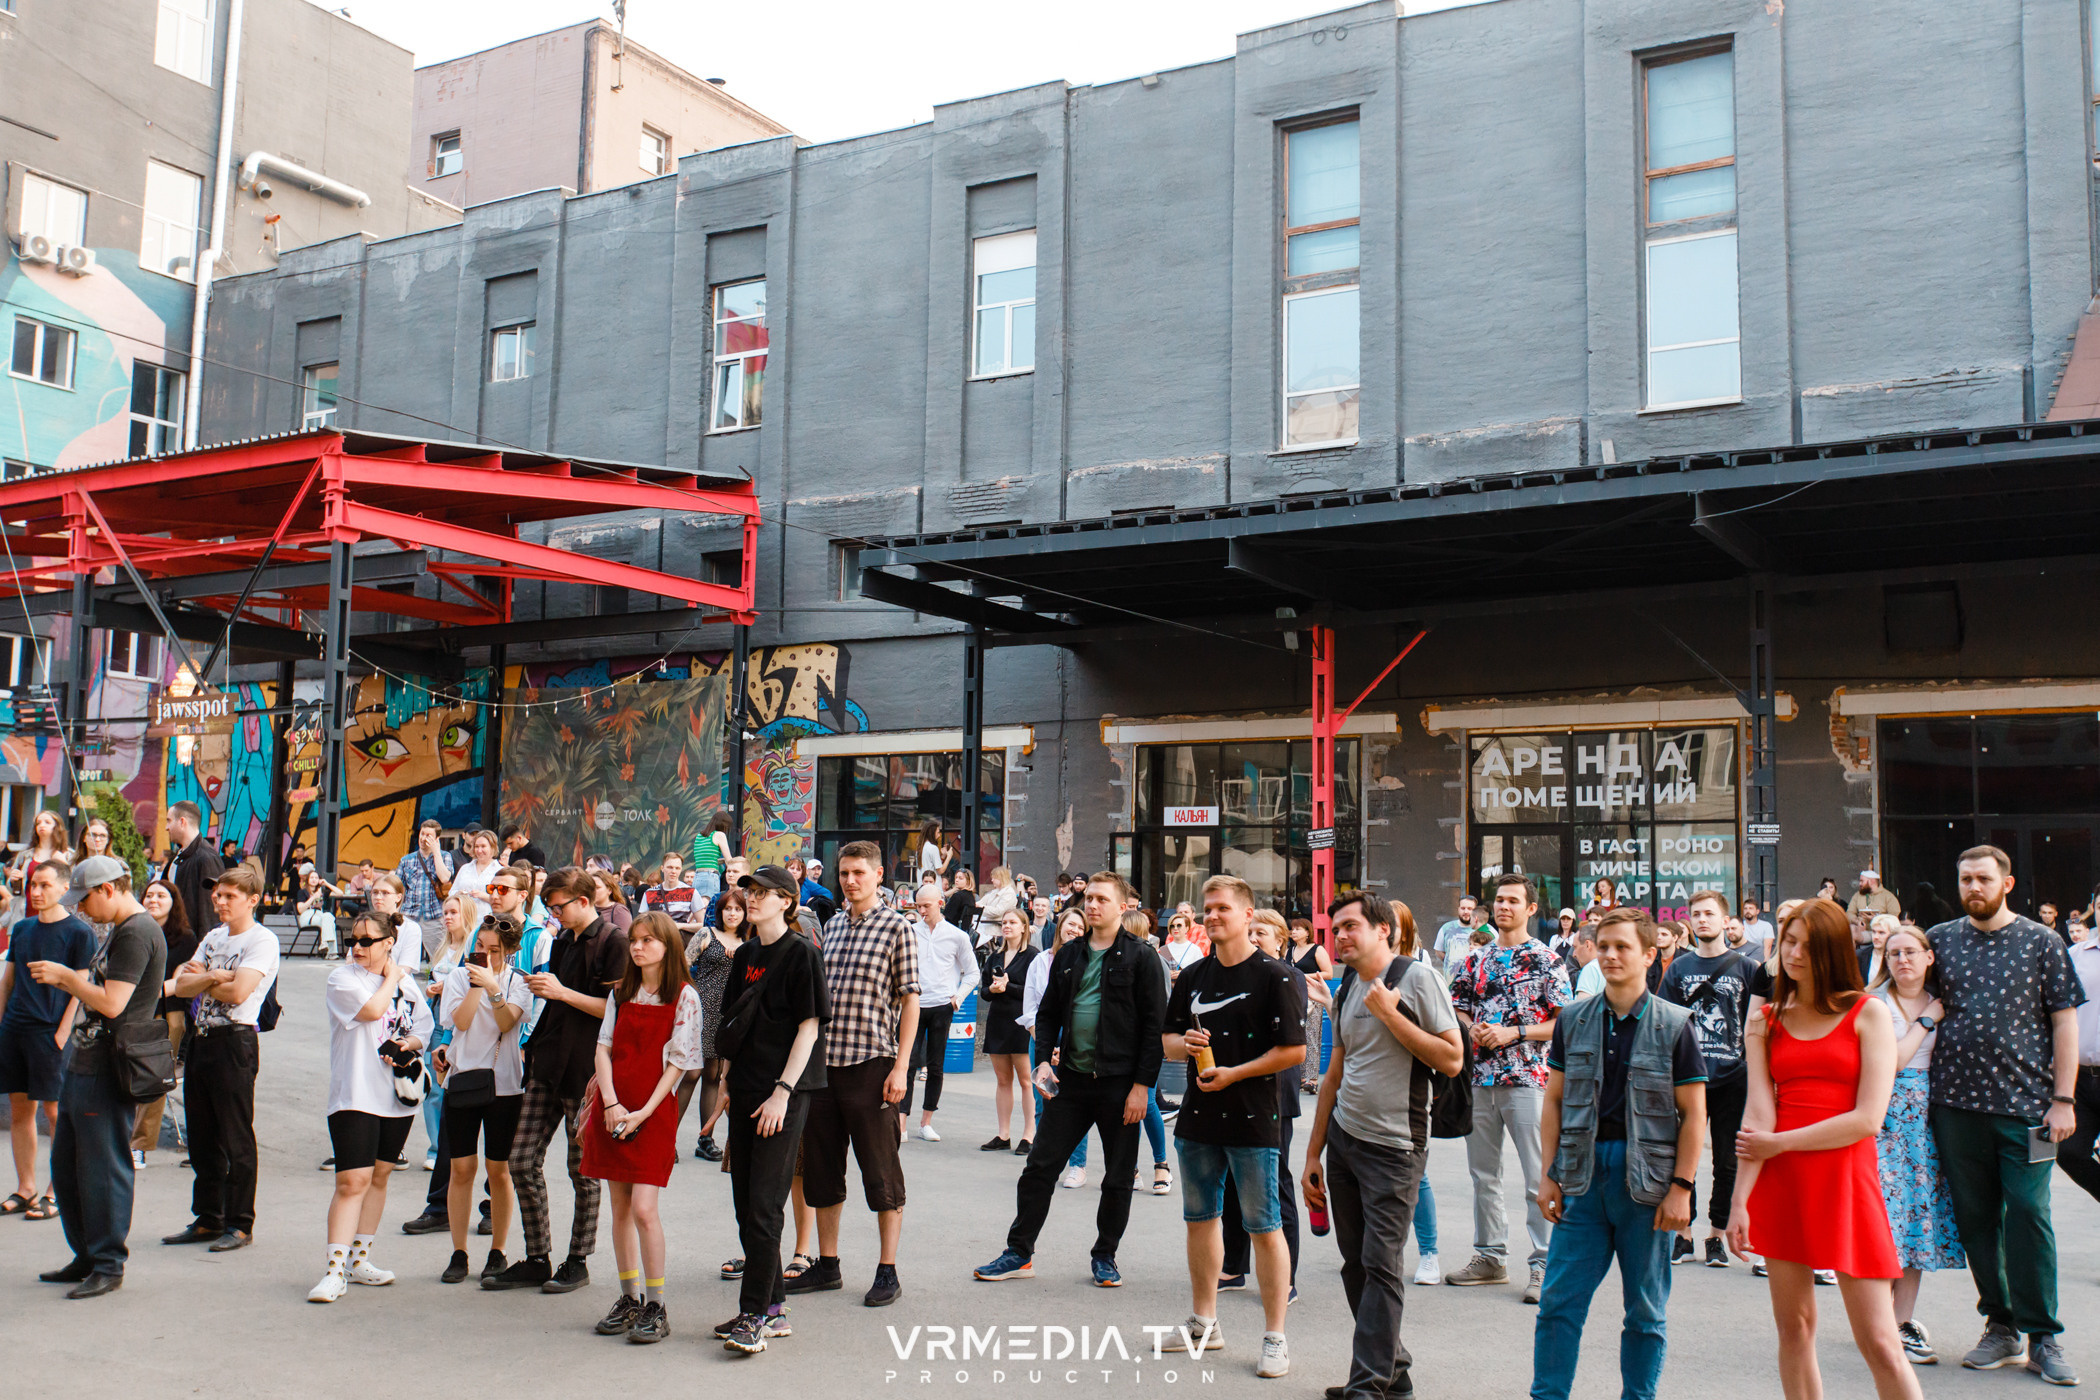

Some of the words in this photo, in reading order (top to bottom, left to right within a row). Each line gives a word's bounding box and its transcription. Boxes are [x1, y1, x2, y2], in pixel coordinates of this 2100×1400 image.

[156, 695, 229, 725] jawsspot
[1481, 742, 1687, 778] АРЕНДА
[79, 770, 102, 781] SPOT
[1480, 777, 1696, 810] ПОМЕЩЕНИЙ
[544, 808, 583, 817] СЕРВАНТ
[1174, 809, 1209, 823] КАЛЬЯН
[1580, 839, 1593, 855] В
[1590, 860, 1721, 876] МИЧЕСКОМ
[1581, 881, 1724, 900] КАРТАЛЕ
